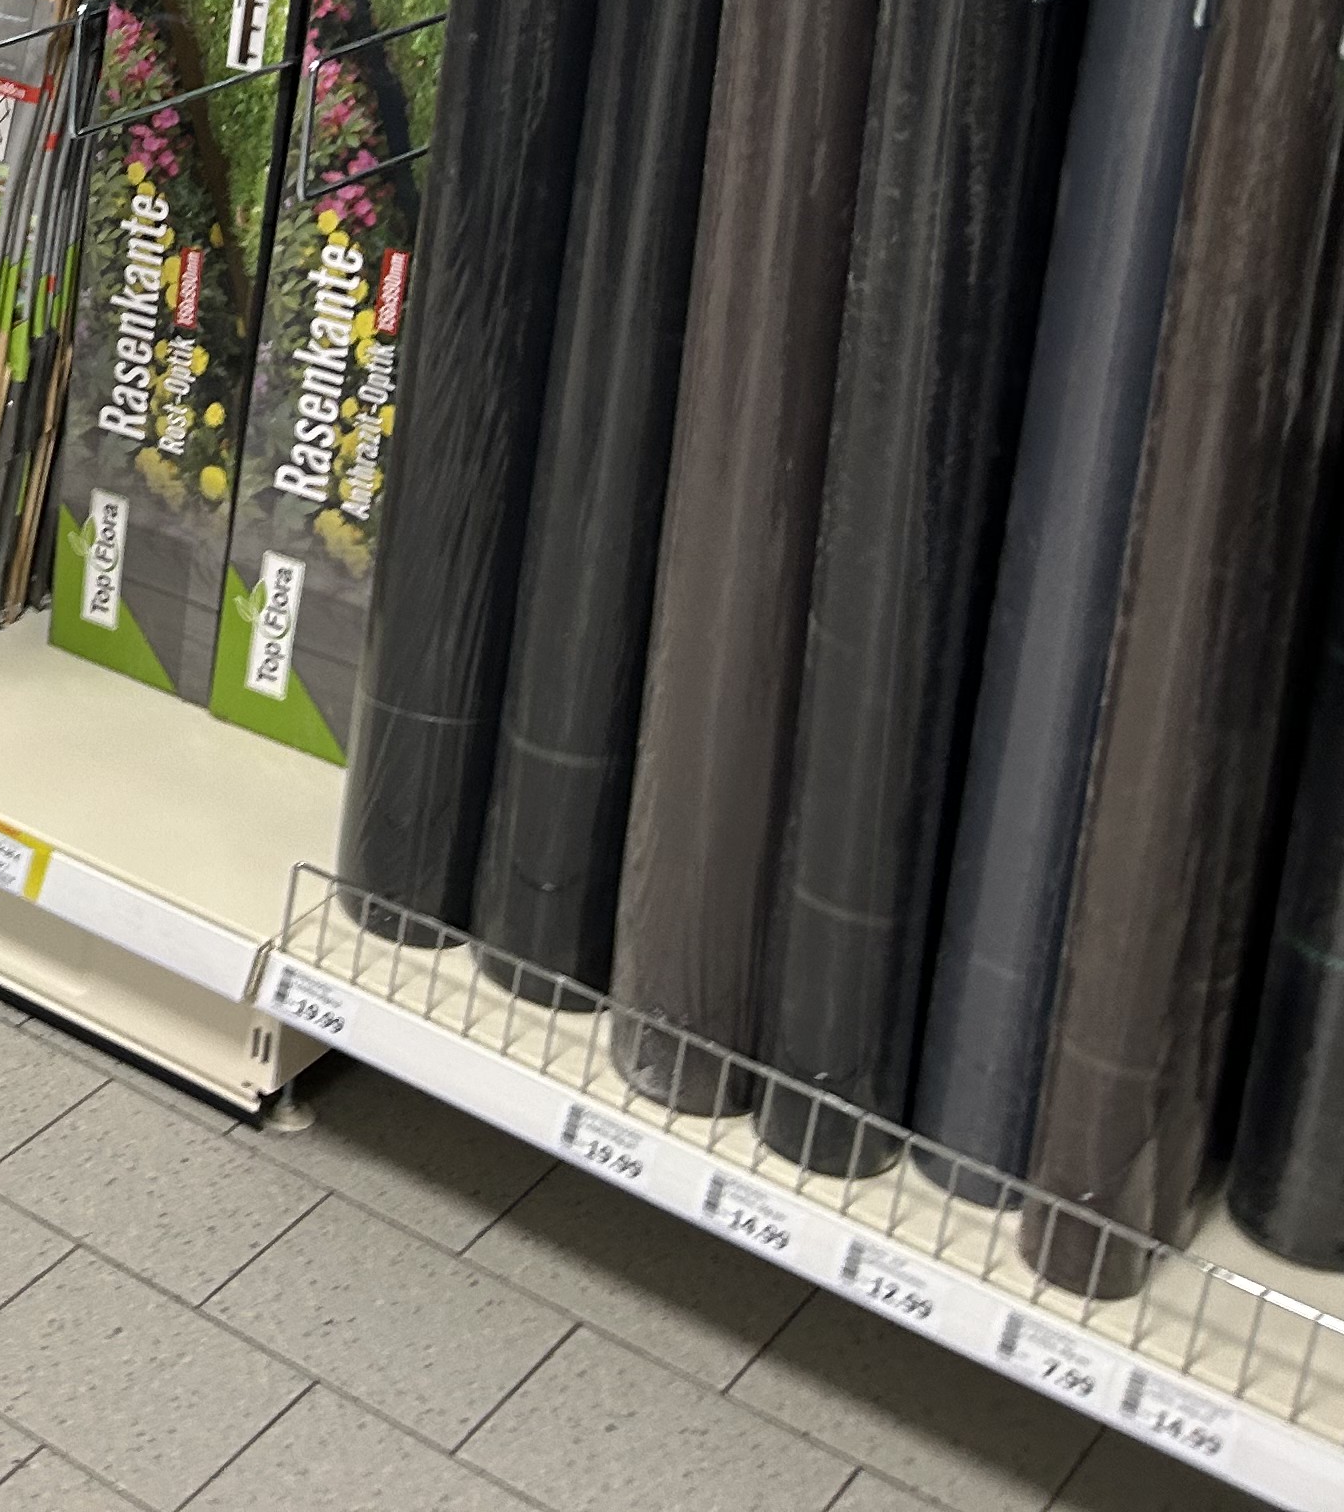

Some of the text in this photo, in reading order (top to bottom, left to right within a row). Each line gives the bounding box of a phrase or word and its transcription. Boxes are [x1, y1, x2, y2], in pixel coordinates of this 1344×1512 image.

[99, 192, 171, 441] Rasenkante
[273, 243, 364, 503] Rasenkante
[158, 335, 197, 456] Rost-Optik
[341, 342, 396, 521] Anthrazit-Optik
[89, 503, 119, 613] Top Flora
[256, 567, 294, 682] Top Flora
